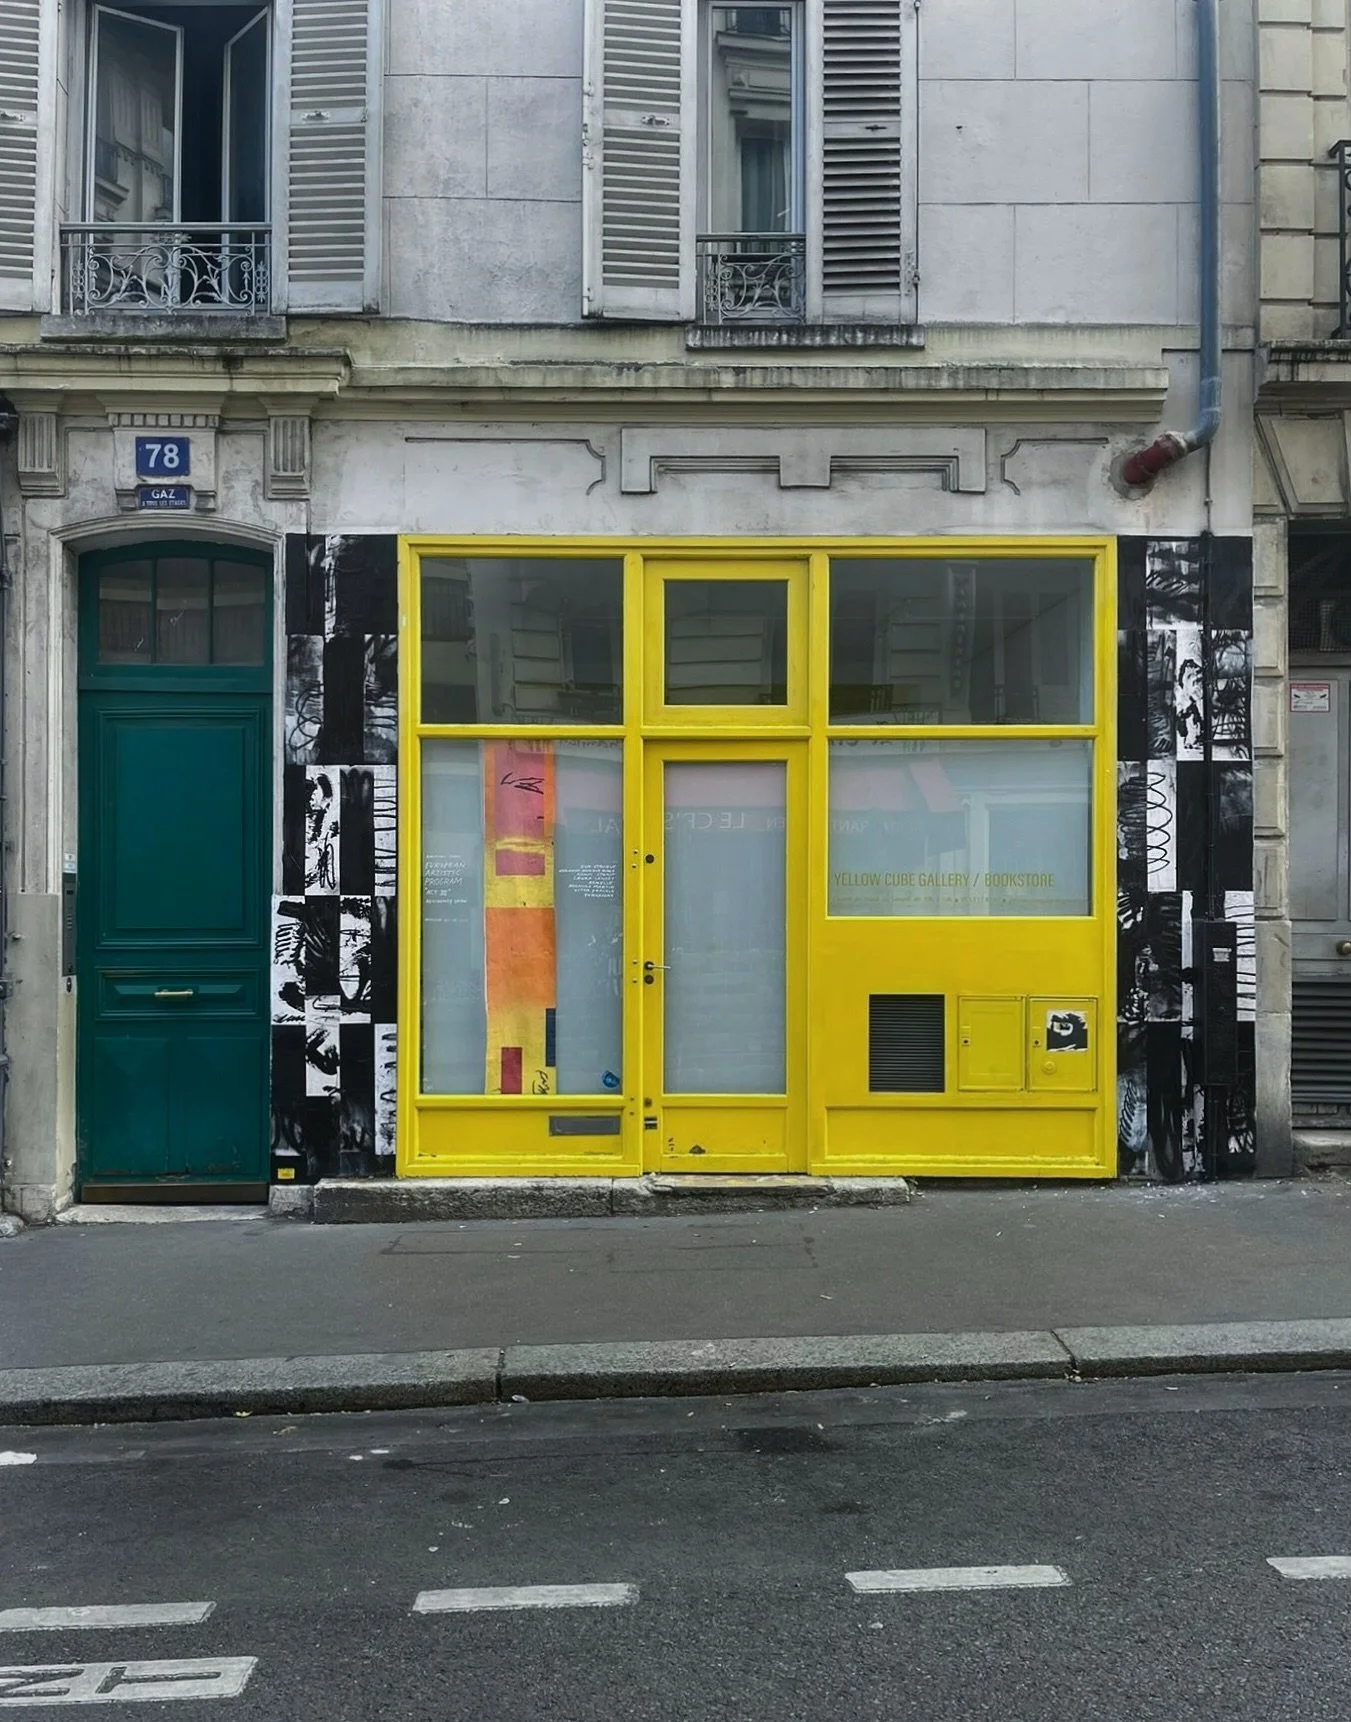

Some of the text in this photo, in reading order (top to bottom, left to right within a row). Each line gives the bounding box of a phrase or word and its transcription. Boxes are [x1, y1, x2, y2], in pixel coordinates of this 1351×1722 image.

[145, 443, 180, 469] 78
[151, 488, 176, 499] GAZ
[834, 872, 881, 887] YELLOW
[884, 872, 916, 887] CUBE
[919, 872, 971, 887] GALLERY
[984, 872, 1055, 887] BOOKSTORE
